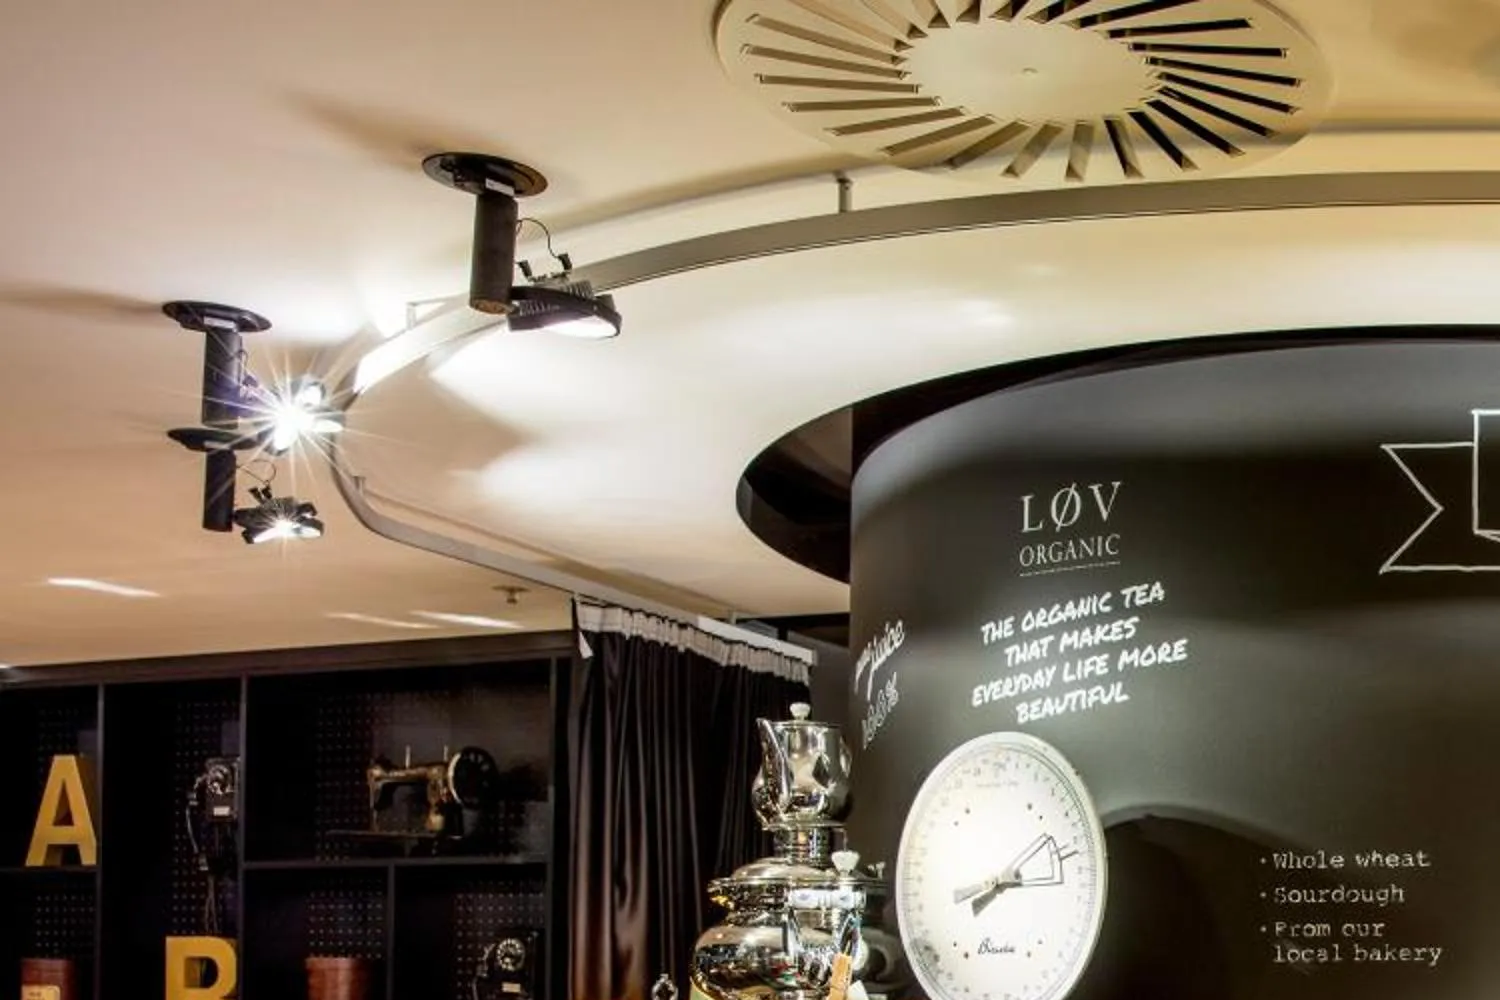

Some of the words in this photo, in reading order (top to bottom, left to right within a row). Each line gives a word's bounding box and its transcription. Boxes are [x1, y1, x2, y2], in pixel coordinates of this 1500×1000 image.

[1018, 533, 1122, 567] ORGANIC
[980, 616, 1014, 646] THE
[1021, 591, 1112, 633] ORGANIC
[1120, 580, 1166, 608] TEA
[1003, 637, 1049, 668] THAT
[1059, 616, 1140, 654] MAKES
[971, 667, 1056, 707] EVERYDAY
[1062, 653, 1109, 683] LIFE
[1117, 638, 1189, 672] MORE
[1015, 681, 1131, 725] BEAUTIFUL
[1272, 849, 1345, 870] Whole
[1354, 849, 1432, 869] wheat
[1273, 883, 1406, 908] Sourdough
[1274, 920, 1332, 938] From
[1341, 922, 1386, 938] our
[1272, 943, 1344, 964] local
[1352, 942, 1444, 967] bakery
